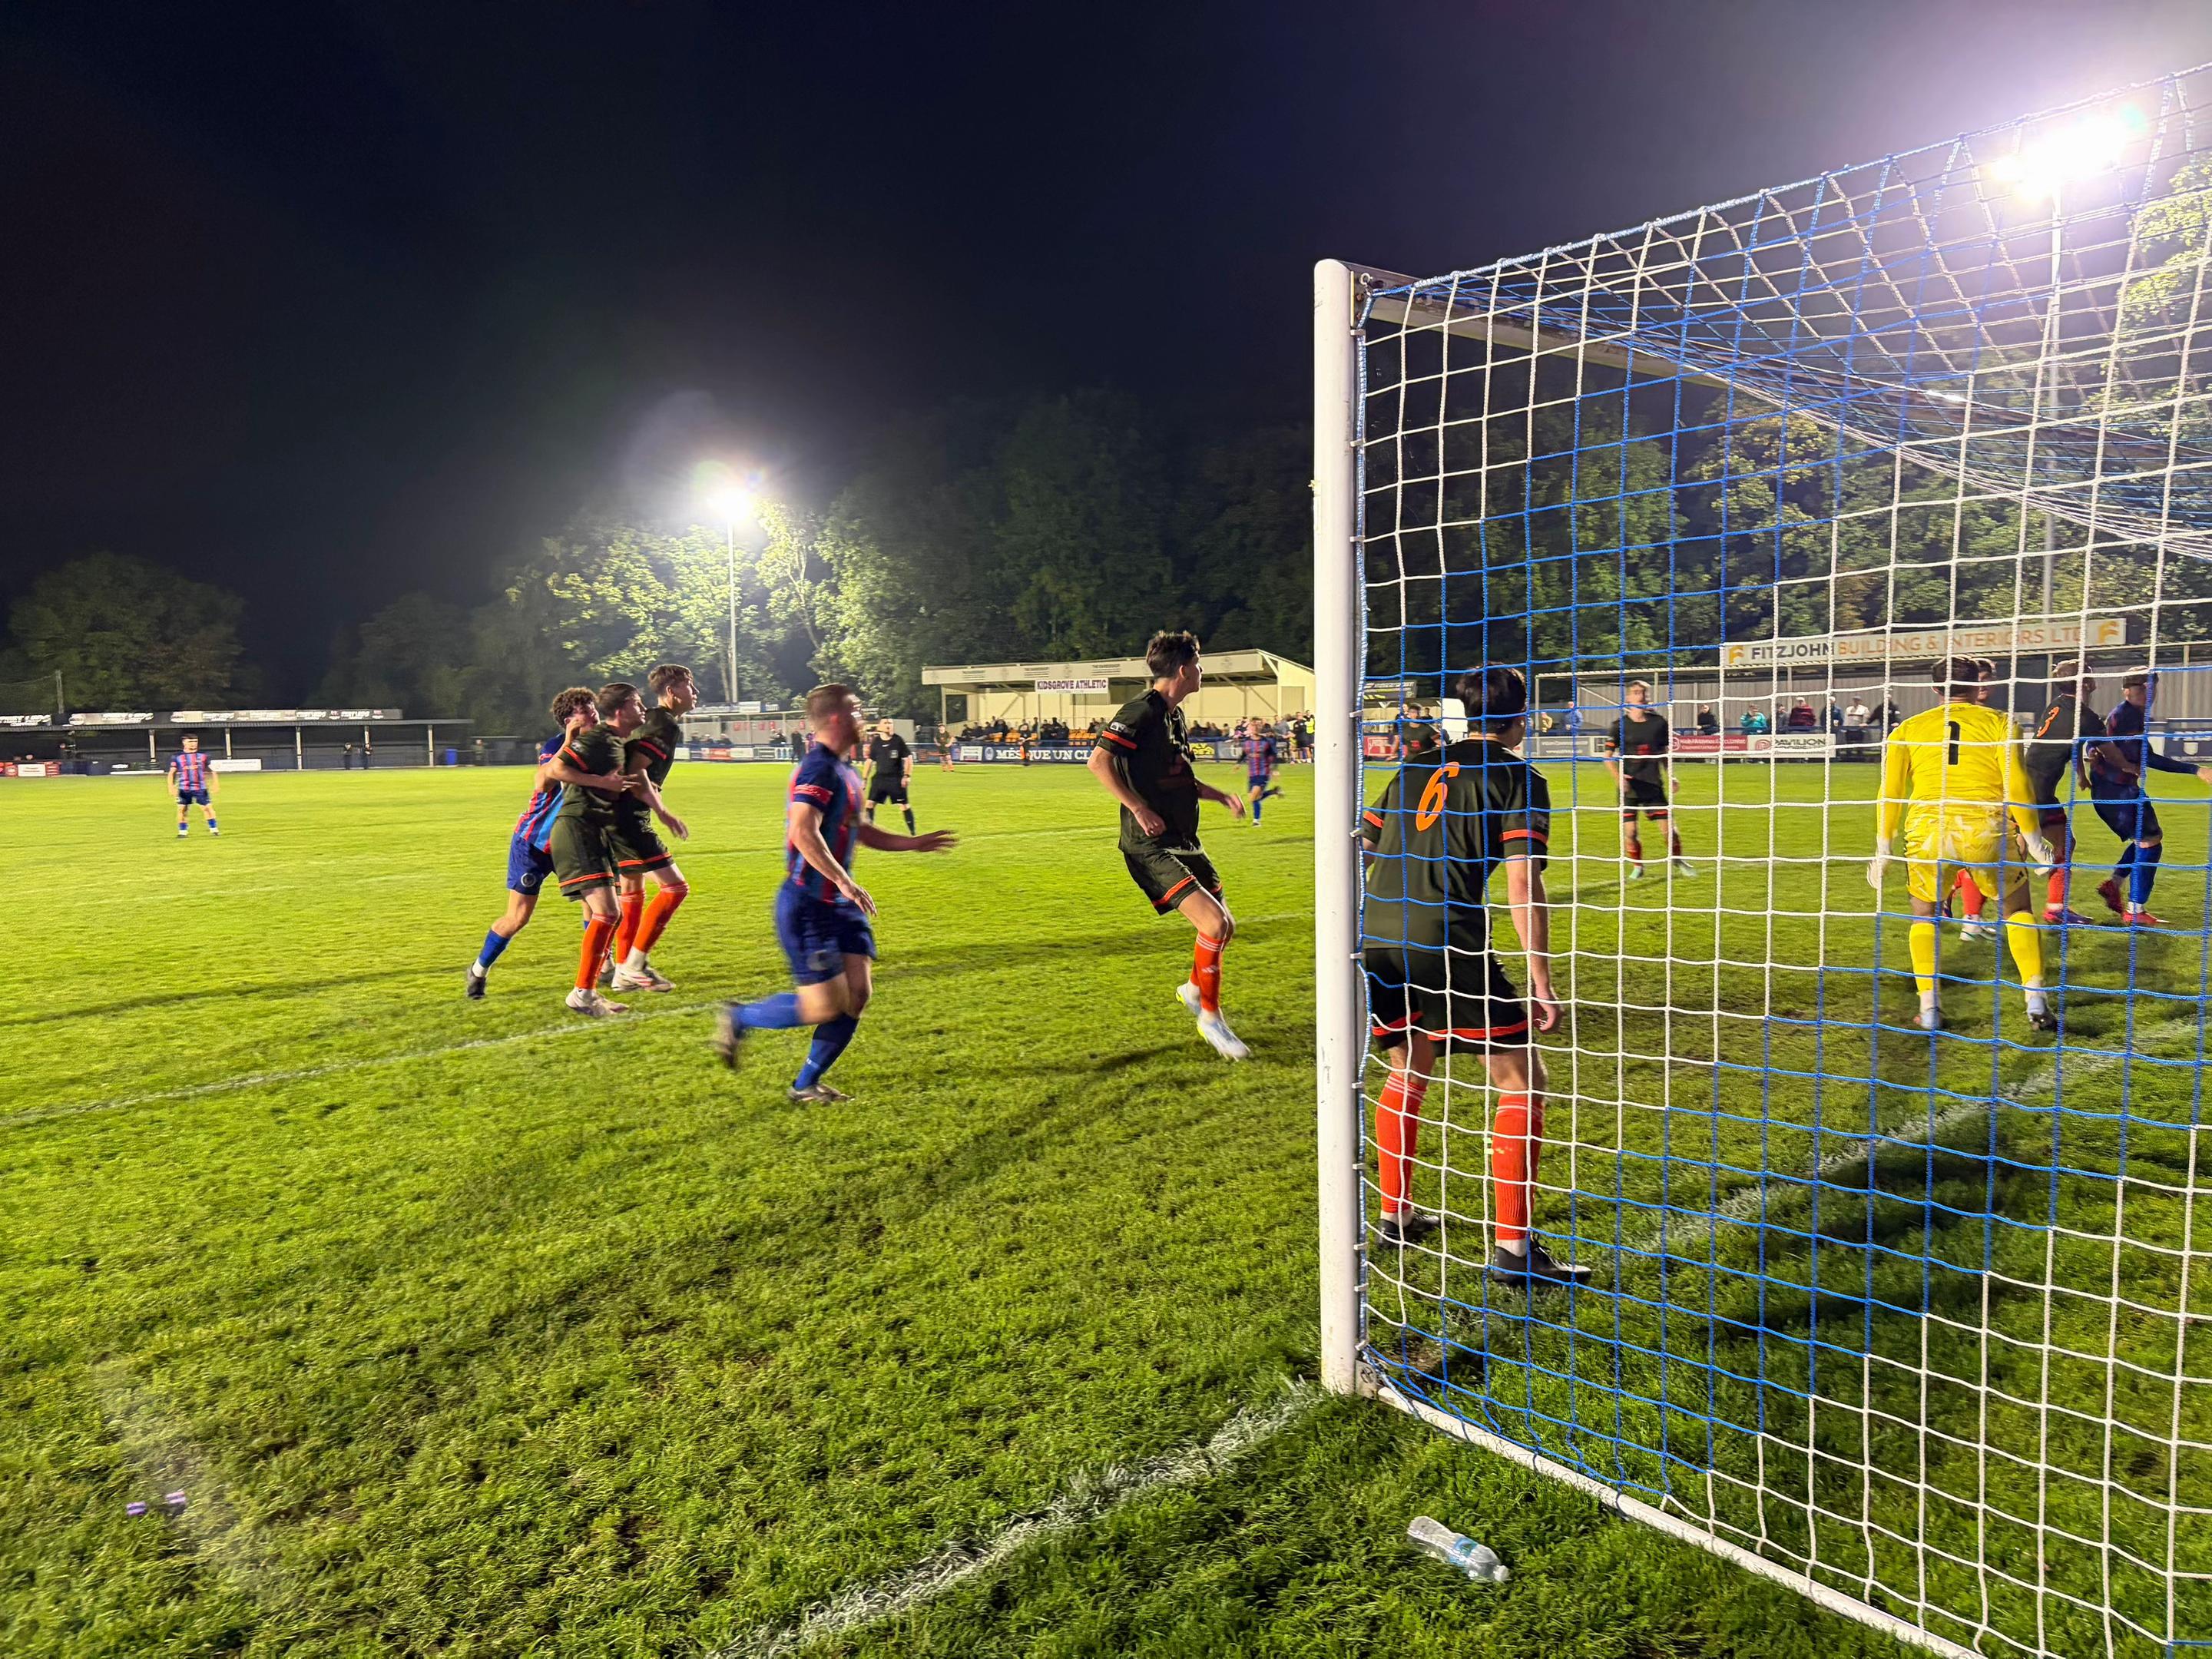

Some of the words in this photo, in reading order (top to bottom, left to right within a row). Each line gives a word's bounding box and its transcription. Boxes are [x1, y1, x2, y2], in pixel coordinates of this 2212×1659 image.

[1751, 642, 1835, 660] FITZJOHN
[1838, 637, 1921, 655] BUILDING
[1926, 635, 1938, 650] &
[1943, 628, 2045, 649] INTERIORS
[1037, 680, 1074, 690] KIDSGROVE
[1075, 679, 1107, 689] ATHLETIC
[2036, 705, 2060, 737] 3
[1052, 750, 1074, 760] UN
[1075, 750, 1093, 760] CL
[1948, 720, 1960, 766] 1
[1415, 761, 1461, 832] 6
